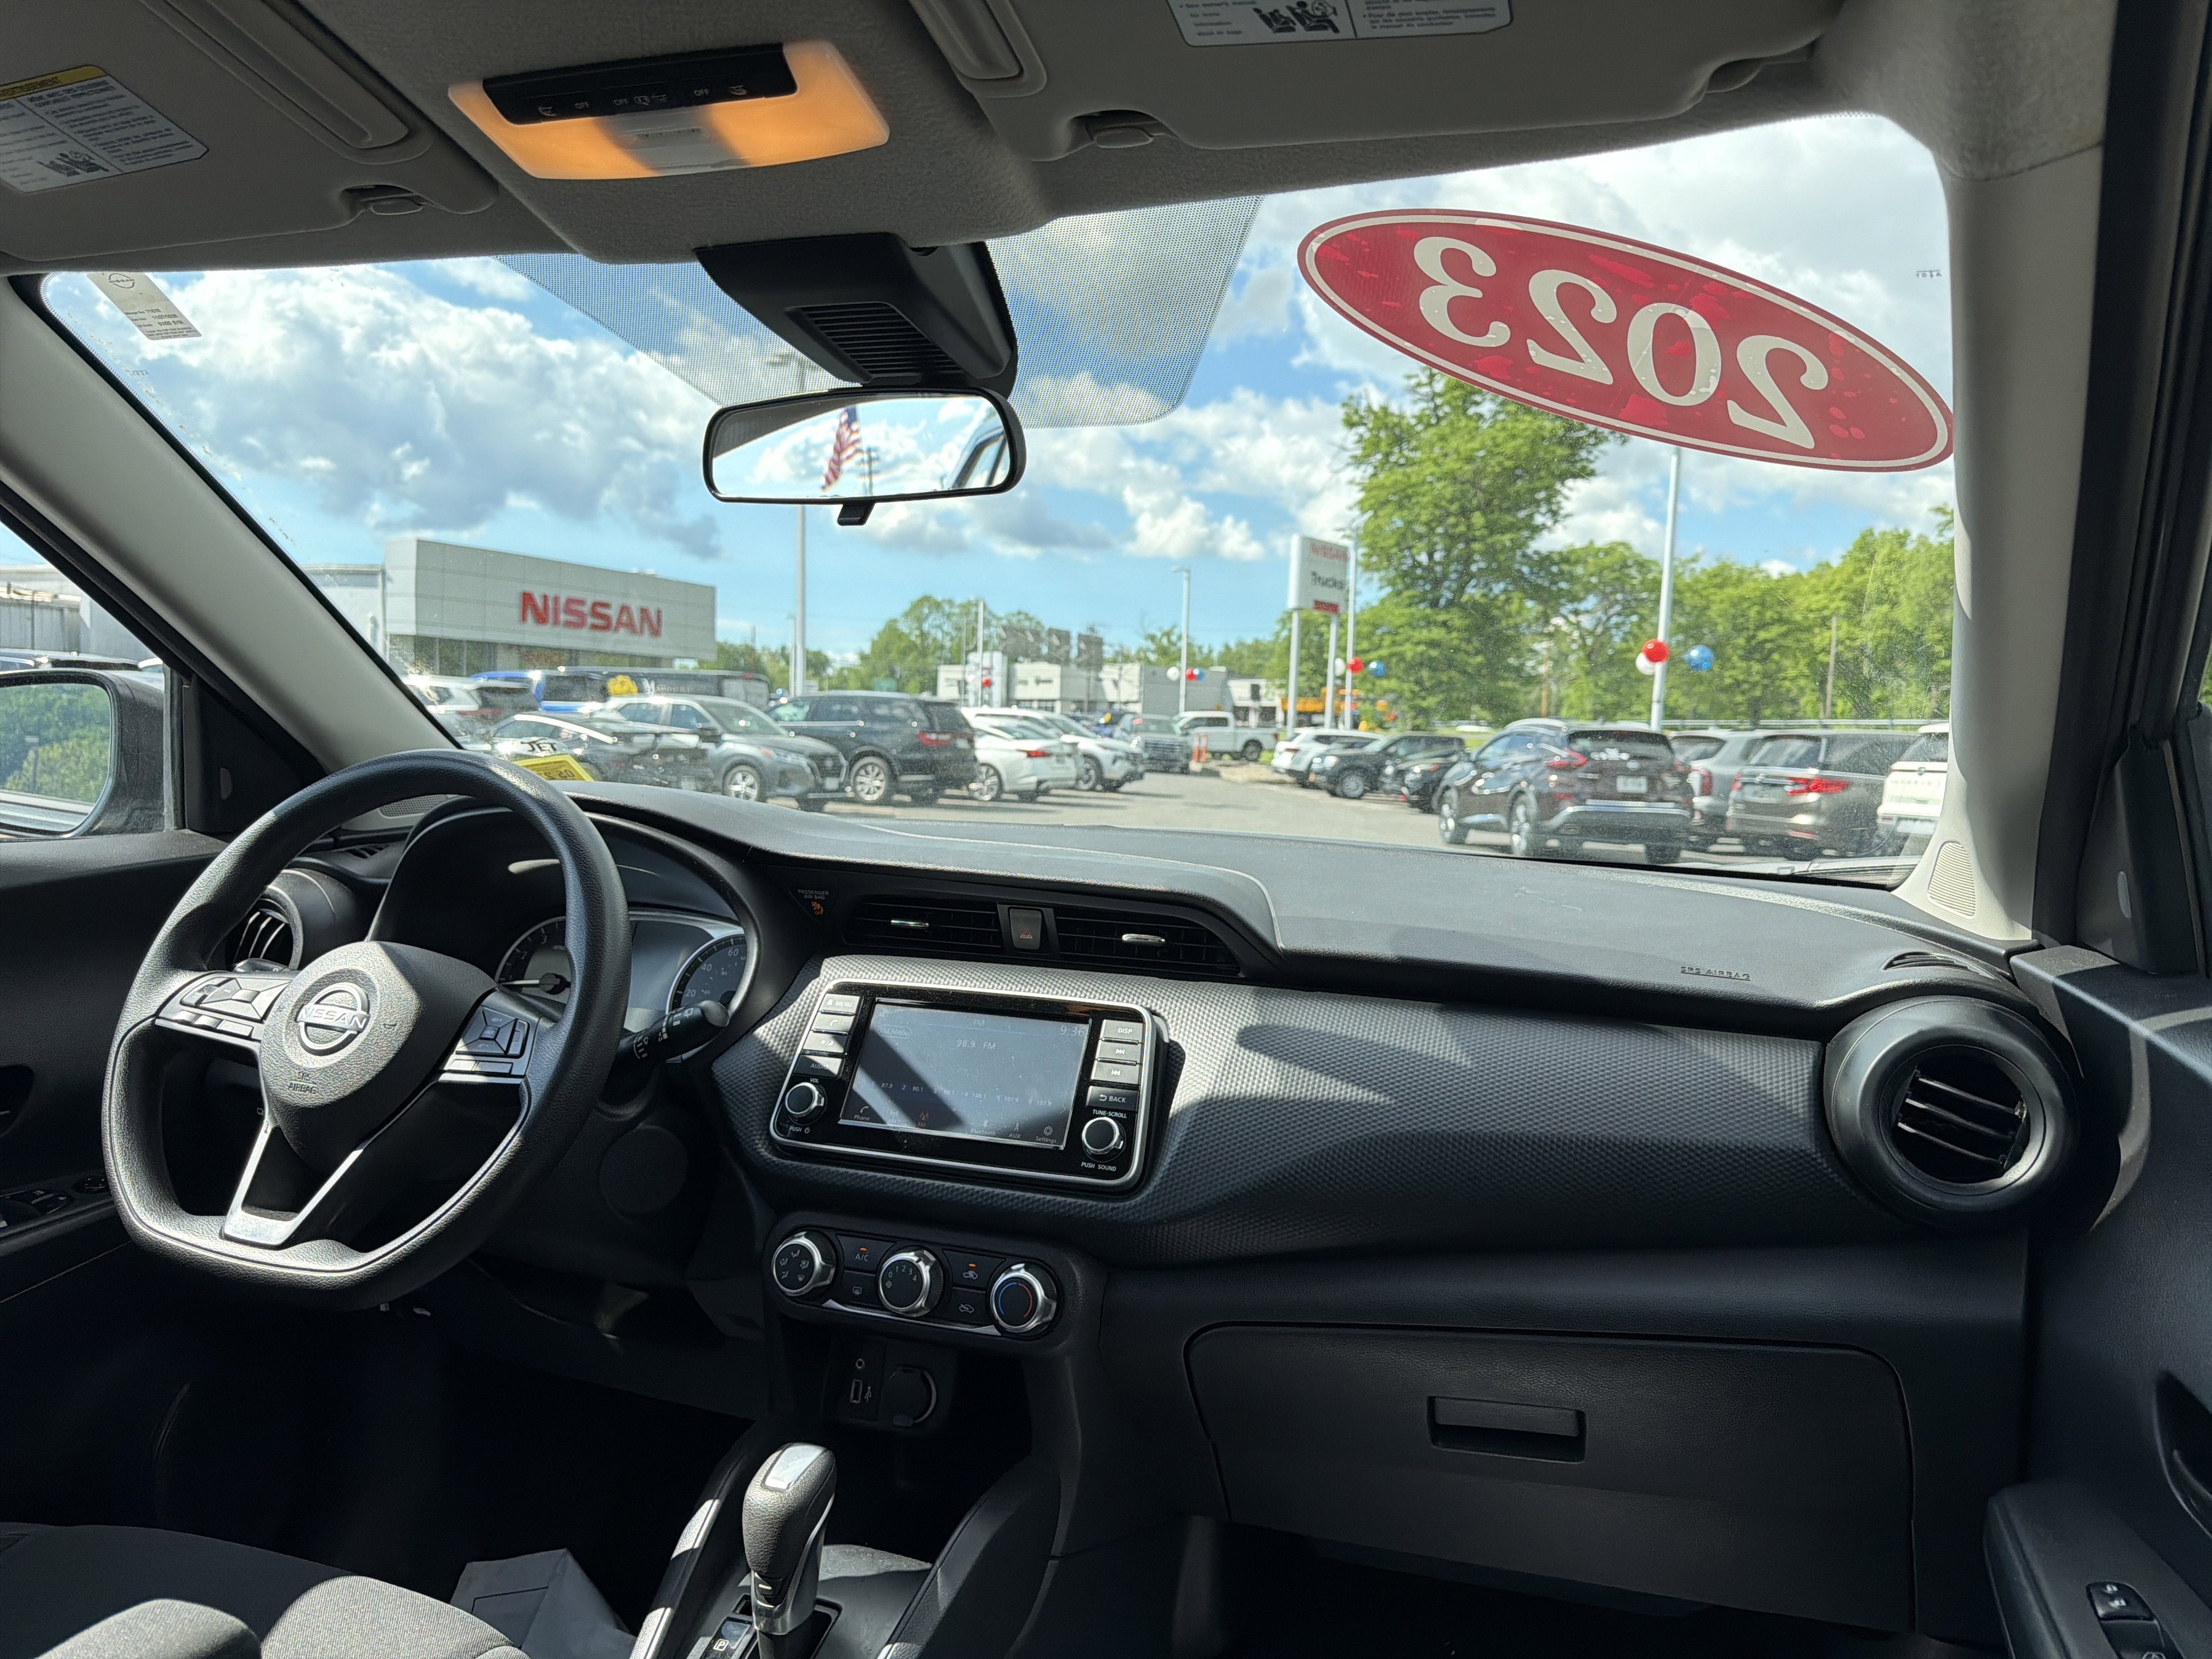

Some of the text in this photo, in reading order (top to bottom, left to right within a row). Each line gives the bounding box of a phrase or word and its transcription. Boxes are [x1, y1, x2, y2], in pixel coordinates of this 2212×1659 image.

[521, 590, 663, 637] NISSAN
[541, 935, 548, 944] 3
[521, 951, 527, 960] 2
[728, 947, 738, 957] 60
[701, 963, 712, 972] 40
[1705, 969, 1751, 980] AIRBAG
[686, 989, 696, 997] 20
[299, 1007, 367, 1028] NISSAN
[891, 1028, 910, 1036] Menu
[1059, 1024, 1085, 1037] 9:36
[956, 1039, 997, 1050] 98.9 FM
[288, 1082, 317, 1094] AIRBAG
[970, 1127, 996, 1137] Bluetooth
[1035, 1136, 1057, 1144] Settings
[1097, 1164, 1117, 1172] SOUND
[855, 1252, 870, 1262] A/C
